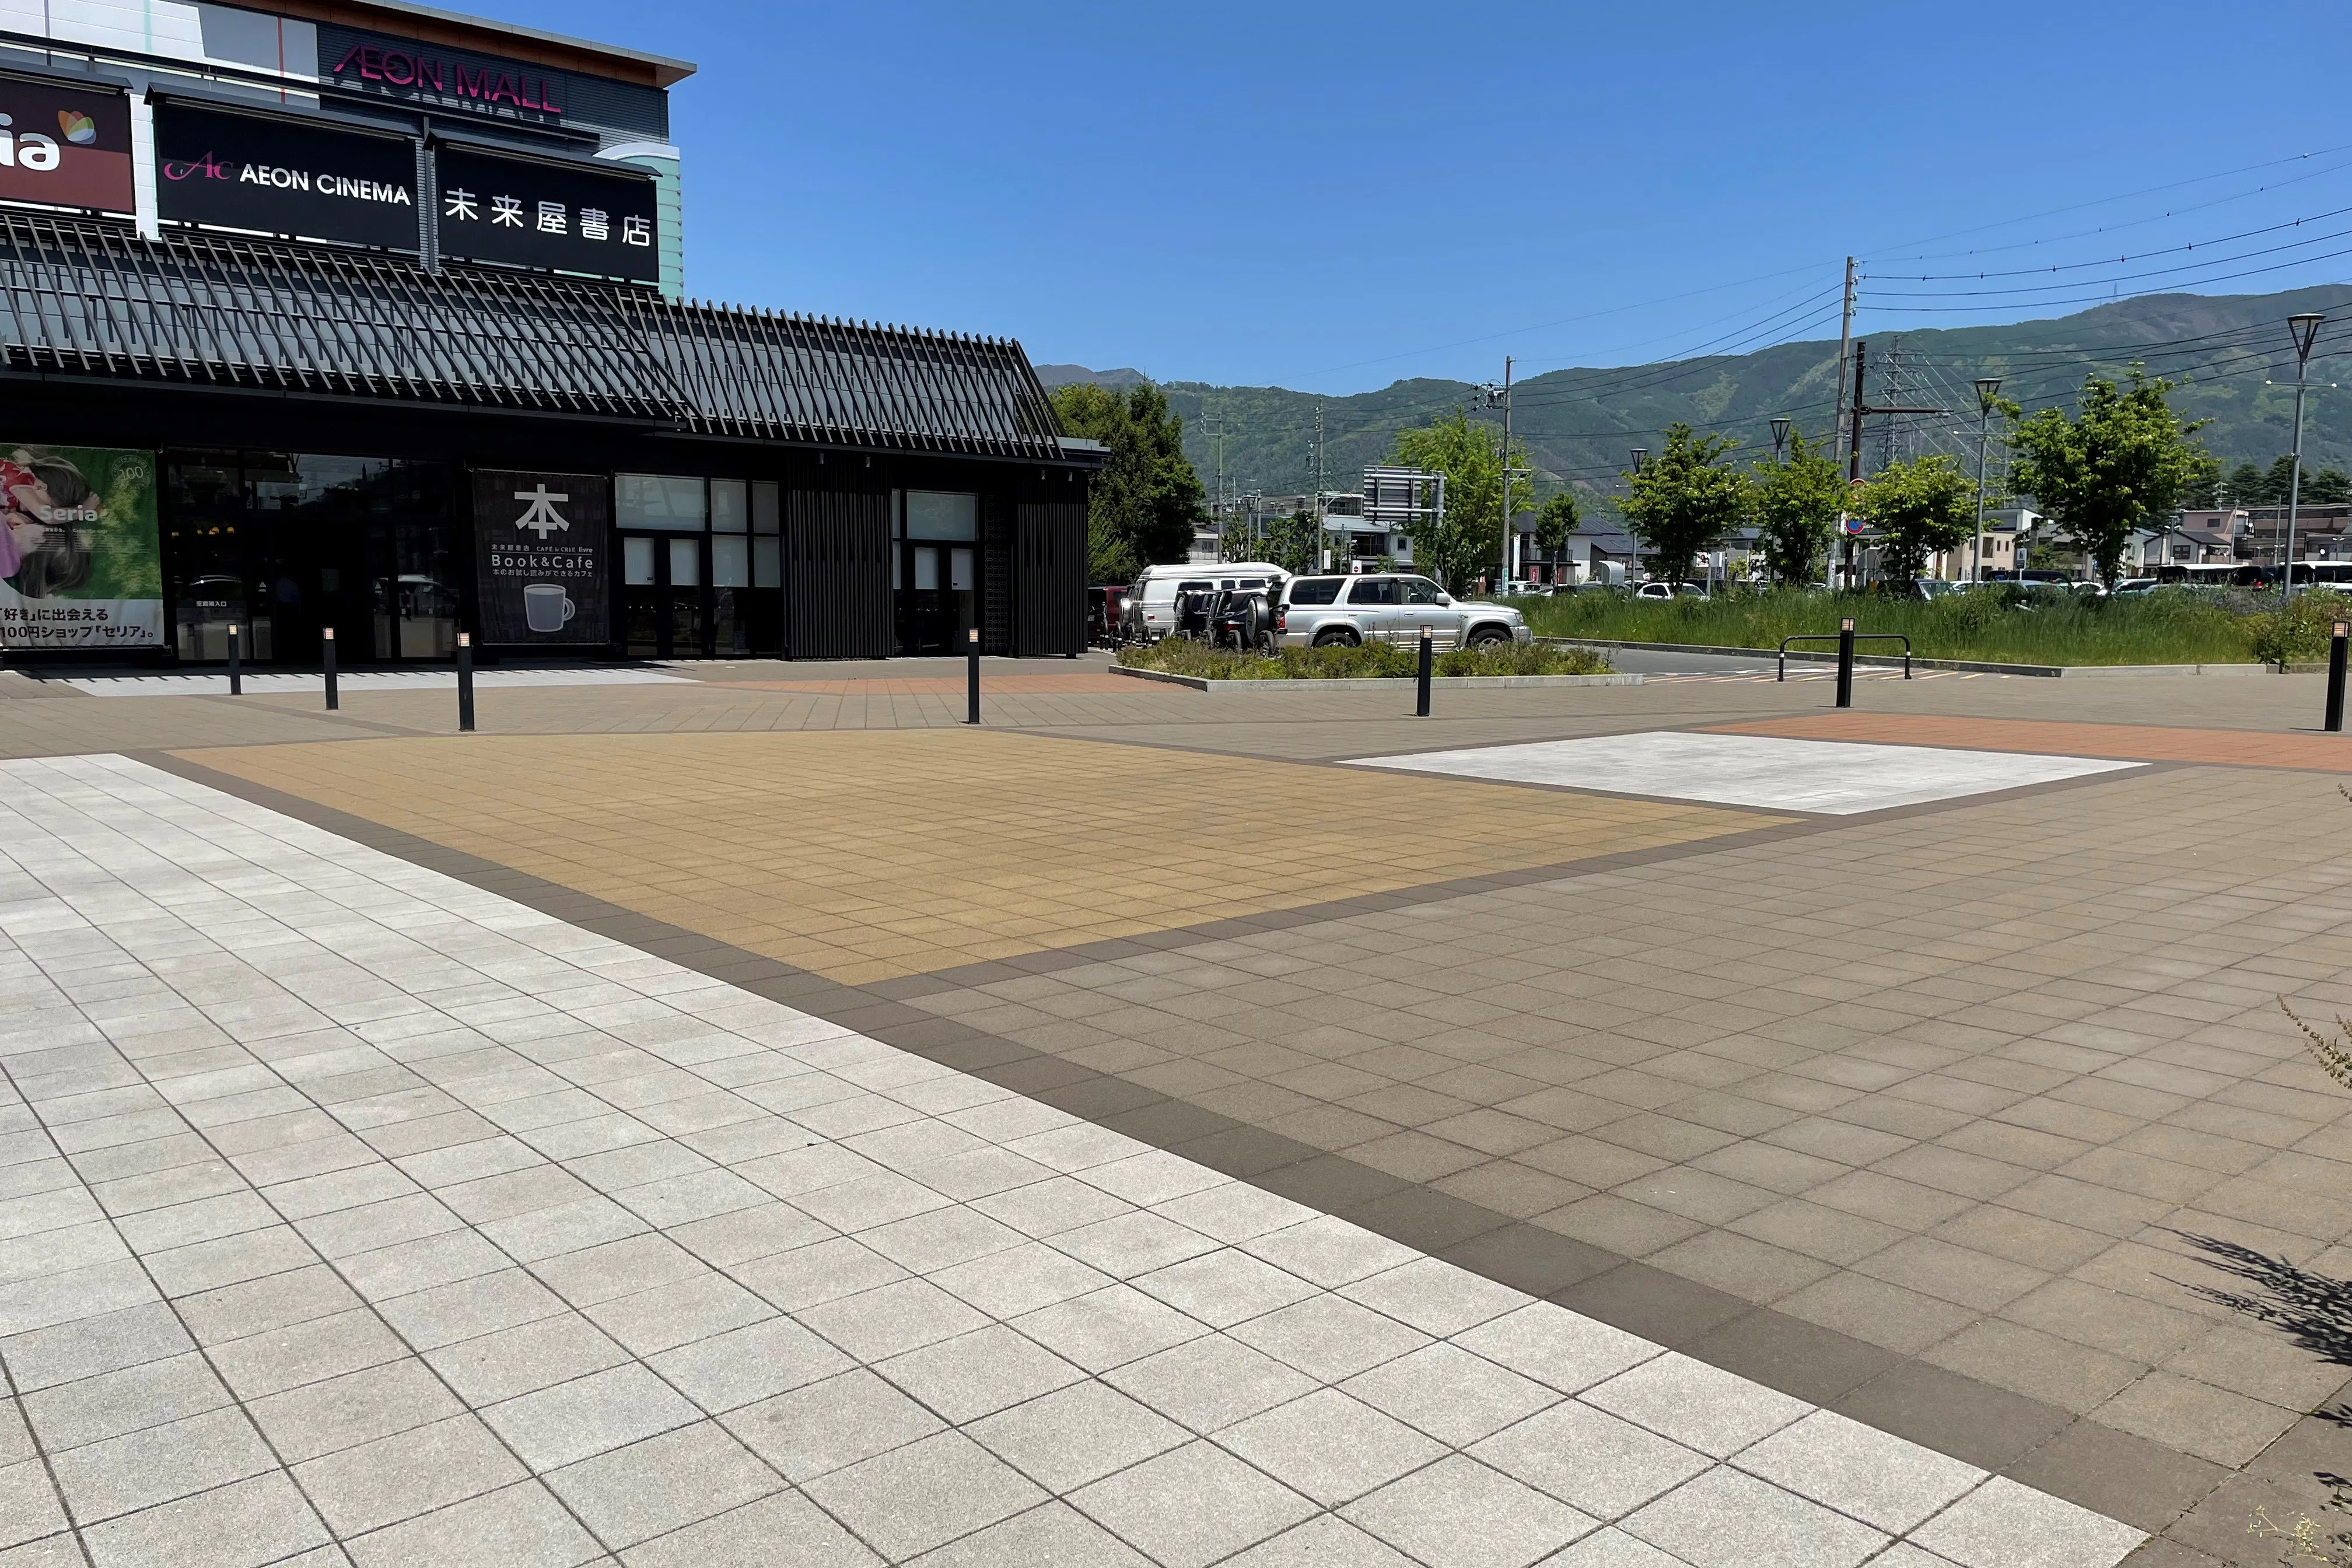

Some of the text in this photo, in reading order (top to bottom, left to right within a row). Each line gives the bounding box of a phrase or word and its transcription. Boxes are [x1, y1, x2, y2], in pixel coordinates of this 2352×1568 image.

[456, 64, 562, 114] MALL
[240, 164, 309, 191] AEON
[317, 174, 411, 206] CINEMA
[445, 188, 650, 246] 未来屋書店
[119, 466, 144, 480] 100
[39, 505, 98, 522] Seria
[514, 484, 570, 540] 本
[0, 608, 108, 621] 好き」に出会える
